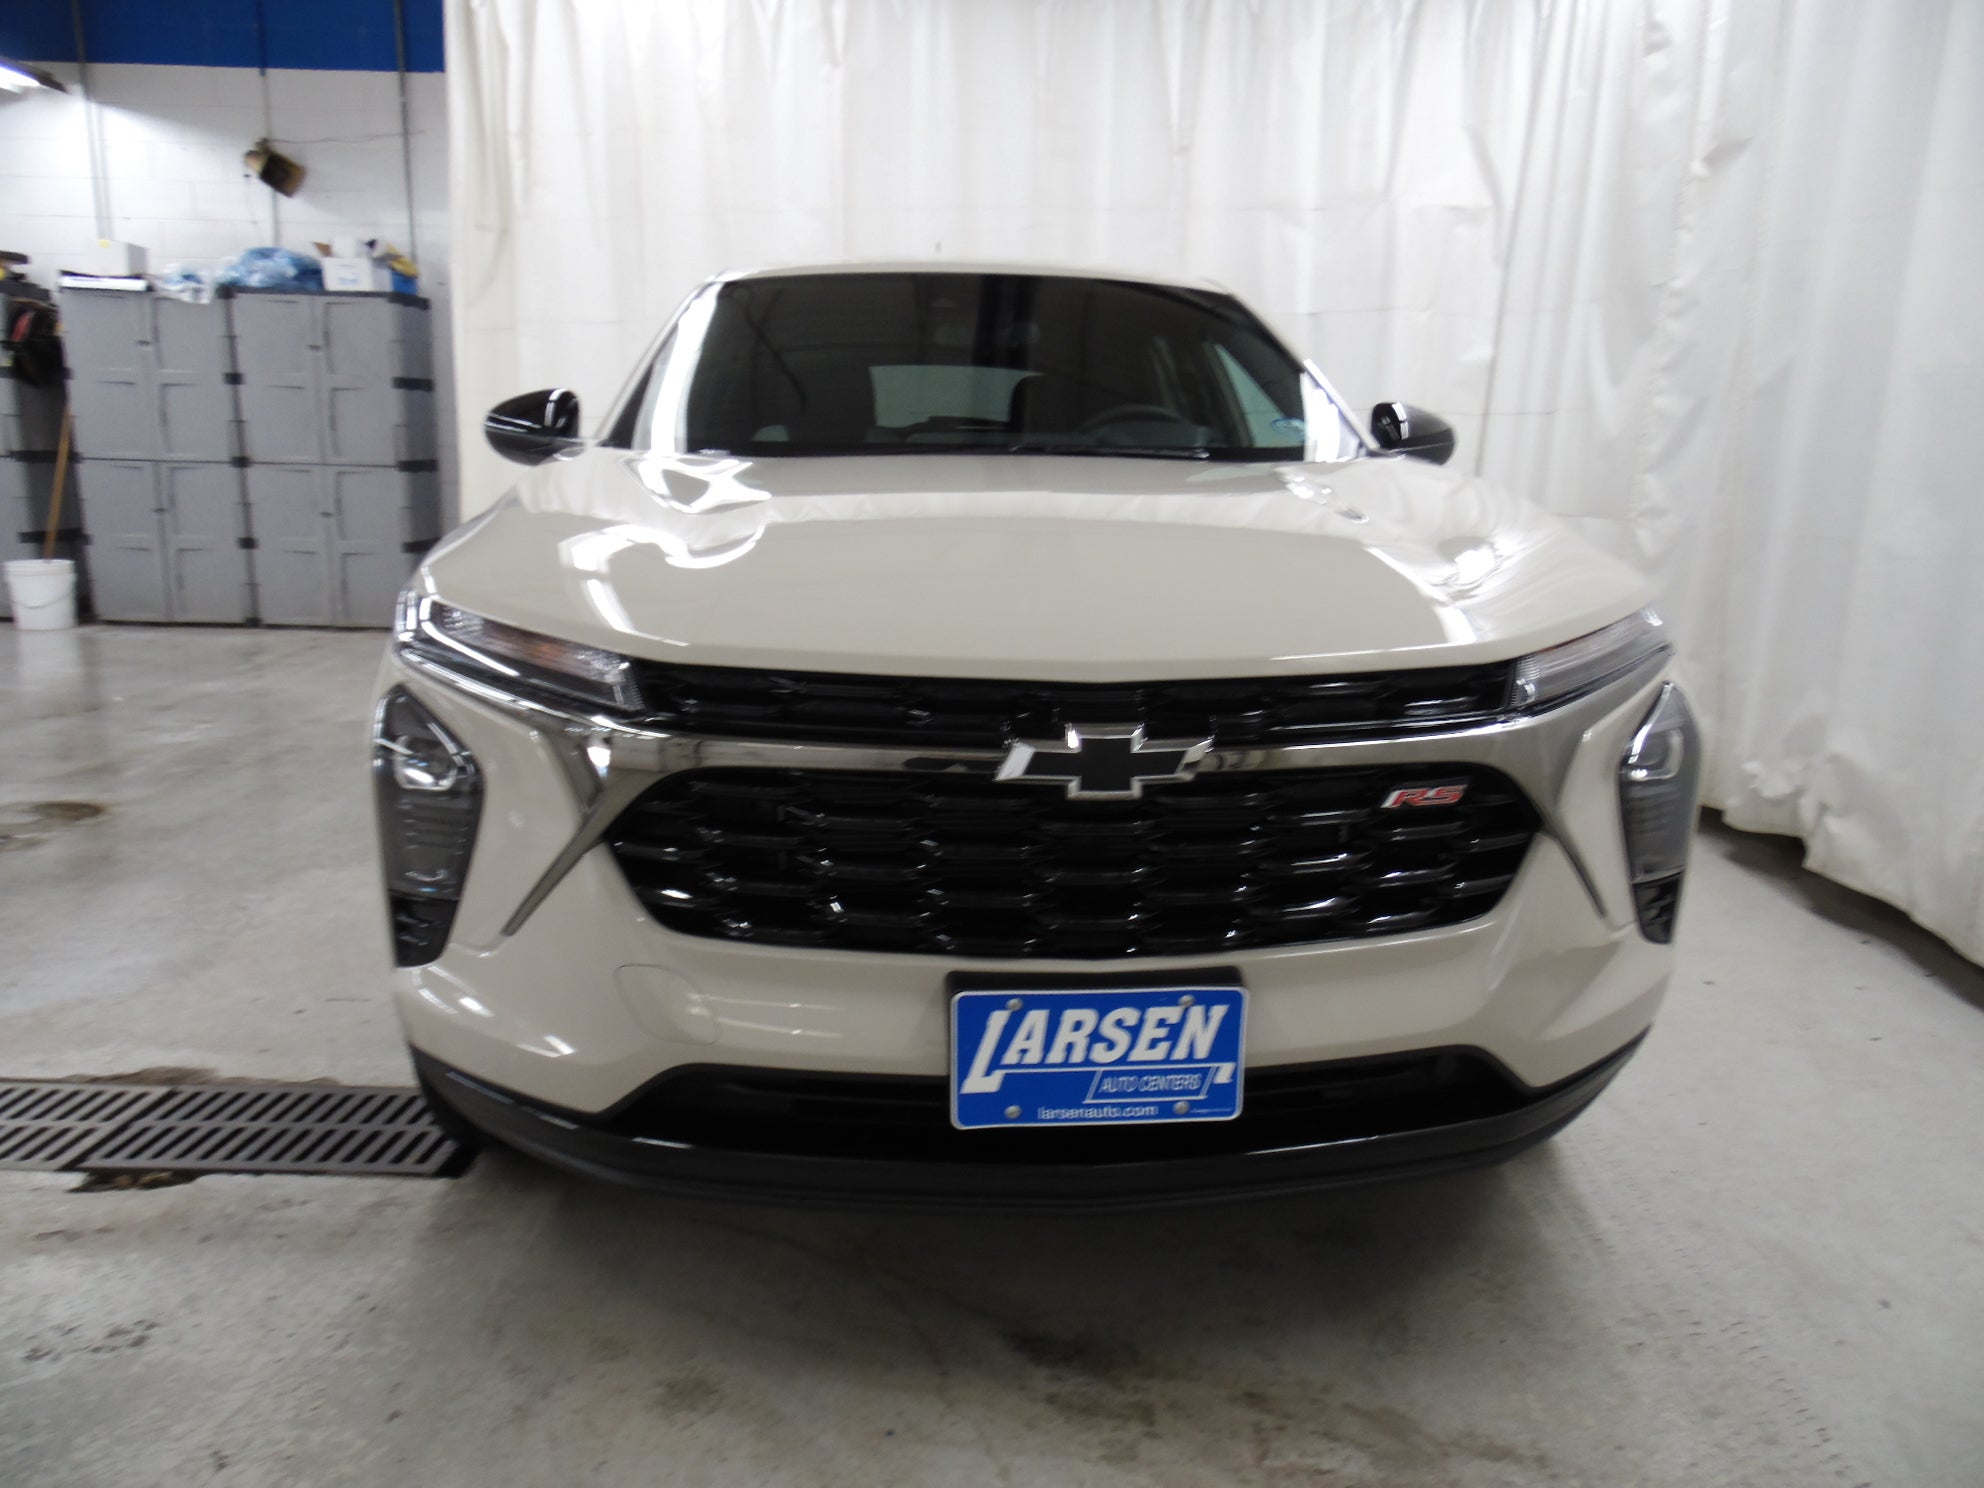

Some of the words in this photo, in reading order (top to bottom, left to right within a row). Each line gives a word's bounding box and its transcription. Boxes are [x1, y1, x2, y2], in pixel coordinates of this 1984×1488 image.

[1380, 784, 1468, 808] RS
[960, 1005, 1229, 1093] LARSEN
[1099, 1076, 1137, 1093] AUTO
[1139, 1073, 1202, 1092] CENTERS
[1037, 1105, 1158, 1120] larsenauto.com
